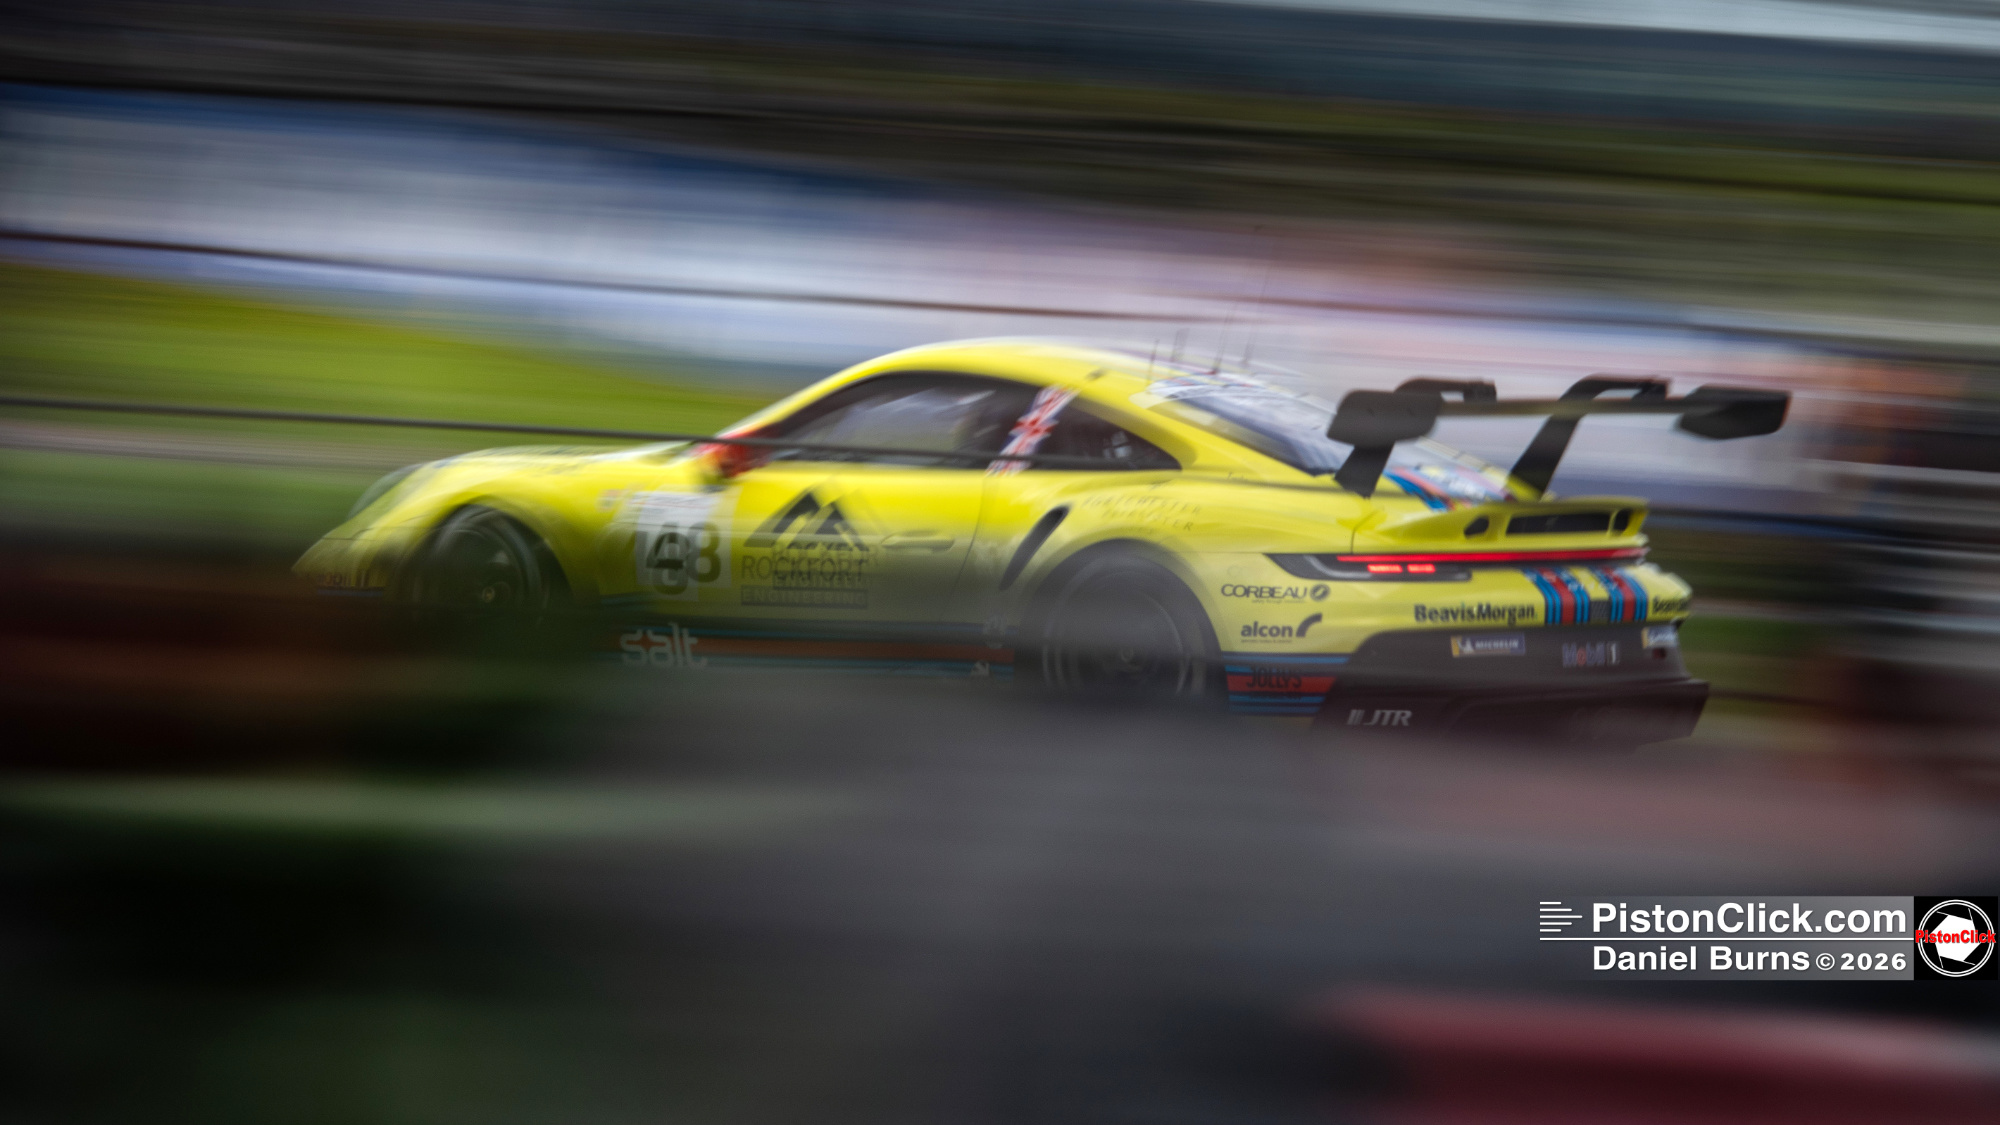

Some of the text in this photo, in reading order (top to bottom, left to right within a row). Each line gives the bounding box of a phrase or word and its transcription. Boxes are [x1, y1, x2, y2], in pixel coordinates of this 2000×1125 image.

[741, 554, 869, 583] ROCKFORT
[1221, 584, 1308, 599] CORBEAU
[1414, 602, 1535, 625] BeavisMorgan
[1240, 621, 1293, 638] alcon
[619, 622, 707, 668] salt
[1363, 709, 1412, 727] JTR
